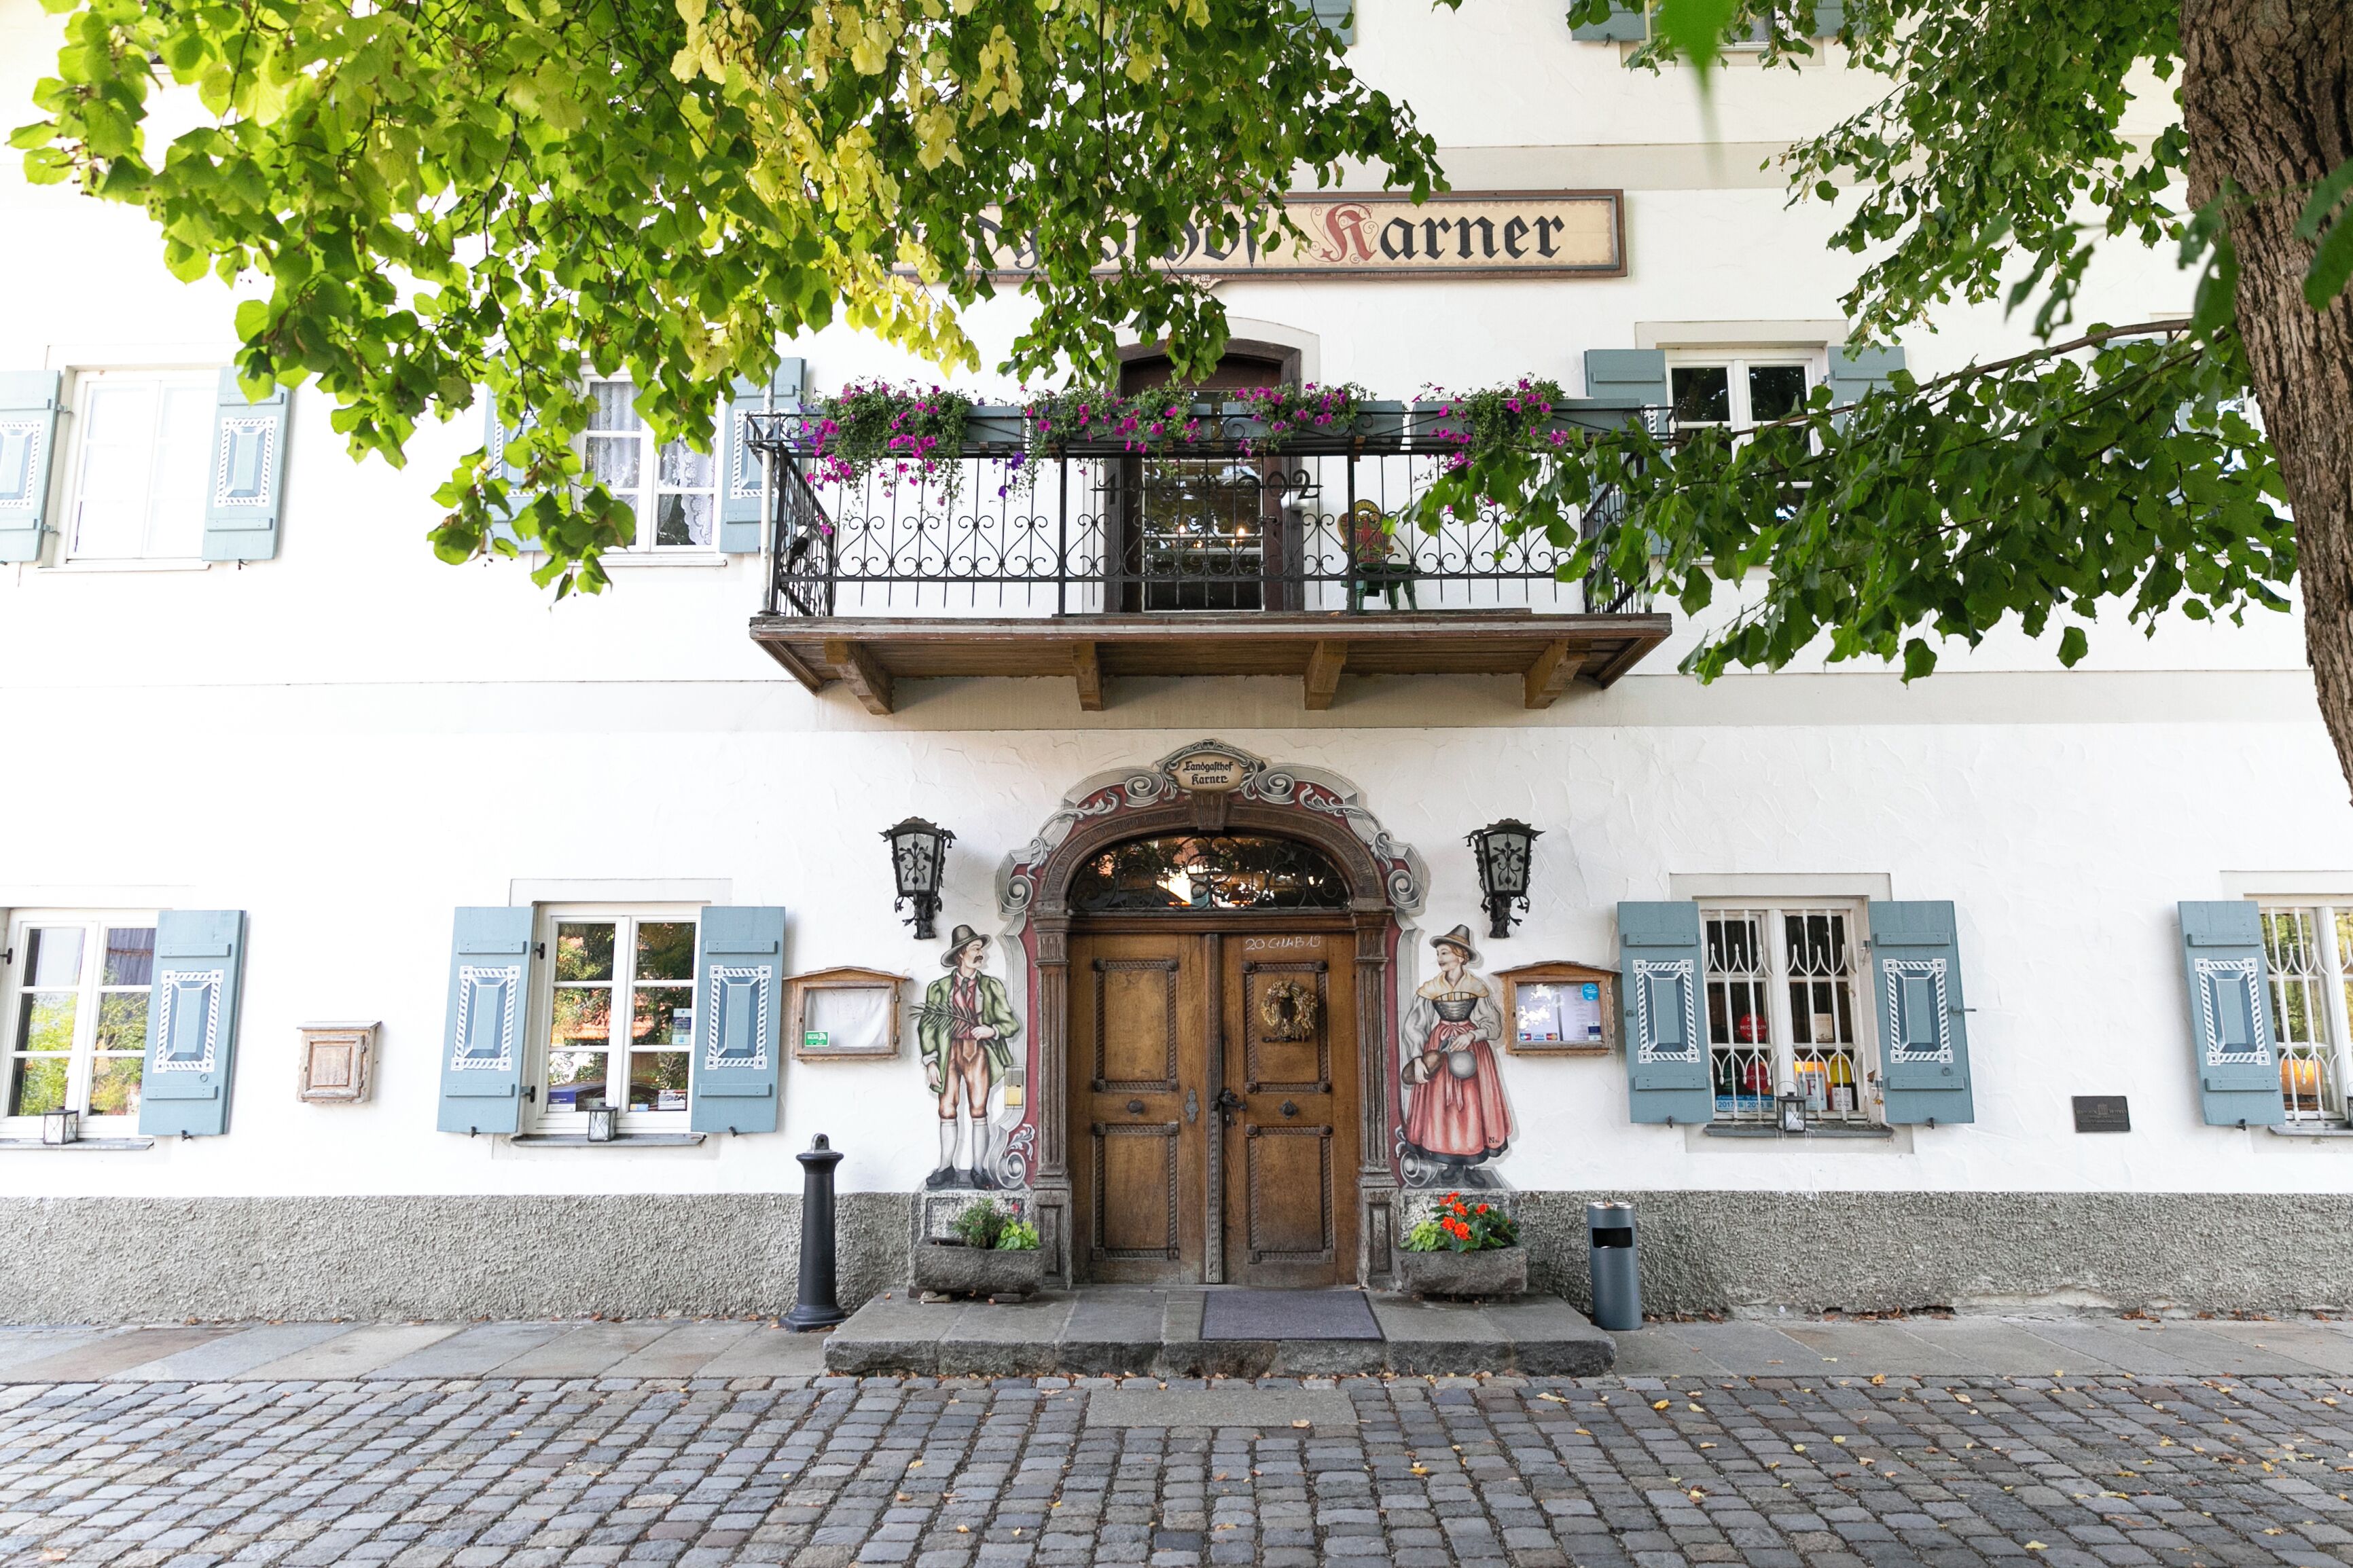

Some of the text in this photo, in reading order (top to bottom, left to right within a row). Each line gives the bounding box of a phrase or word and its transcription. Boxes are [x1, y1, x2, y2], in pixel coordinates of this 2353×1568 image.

[1311, 203, 1565, 263] Karner
[1200, 274, 1211, 282] 82
[1191, 773, 1229, 786] Karner
[1245, 938, 1265, 950] 20
